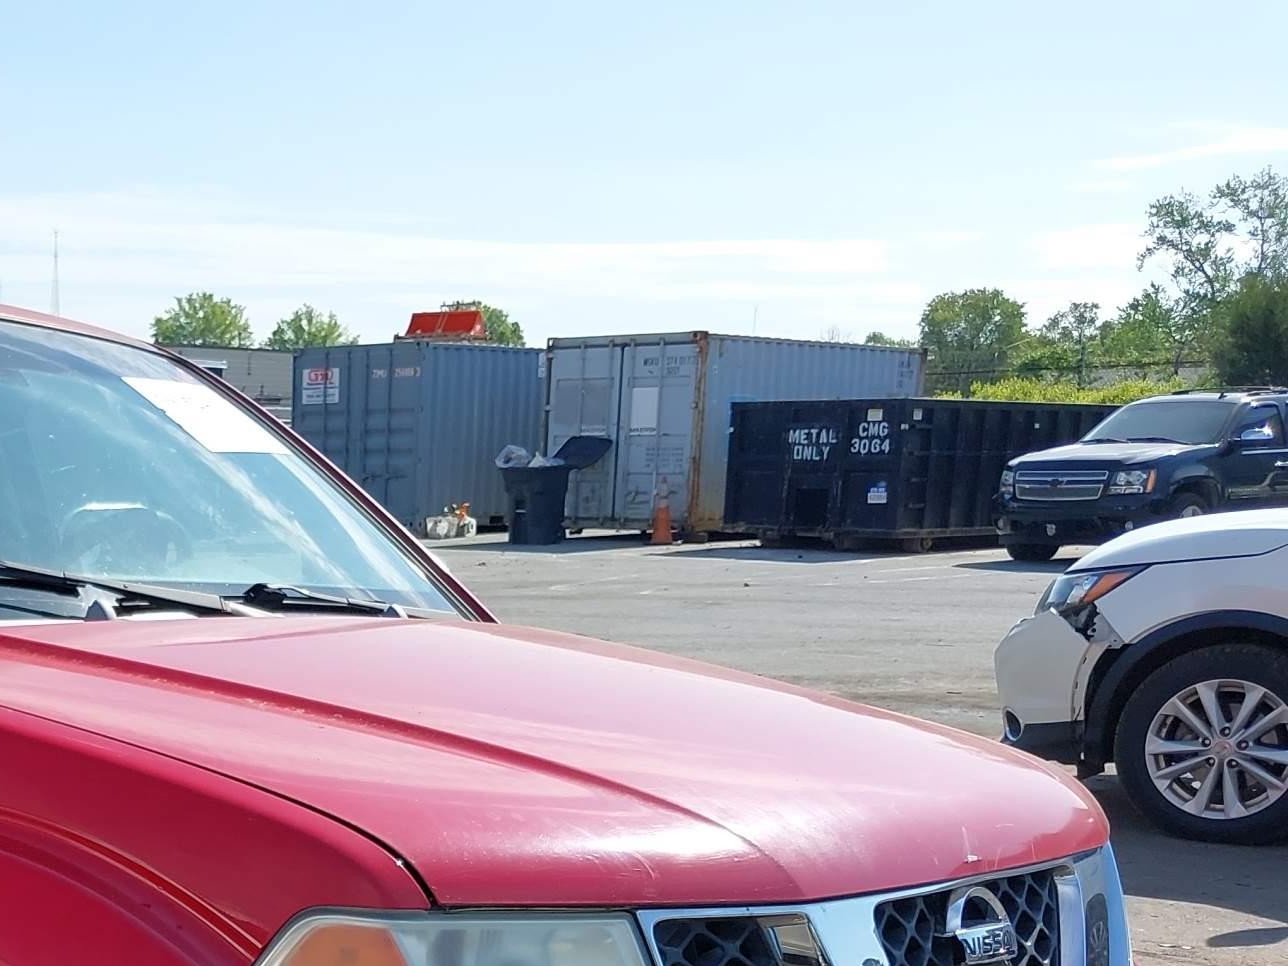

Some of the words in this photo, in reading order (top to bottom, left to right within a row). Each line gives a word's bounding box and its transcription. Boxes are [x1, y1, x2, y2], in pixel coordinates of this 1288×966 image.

[788, 428, 838, 444] METAL
[858, 422, 889, 438] CMG
[793, 445, 830, 461] ONLY
